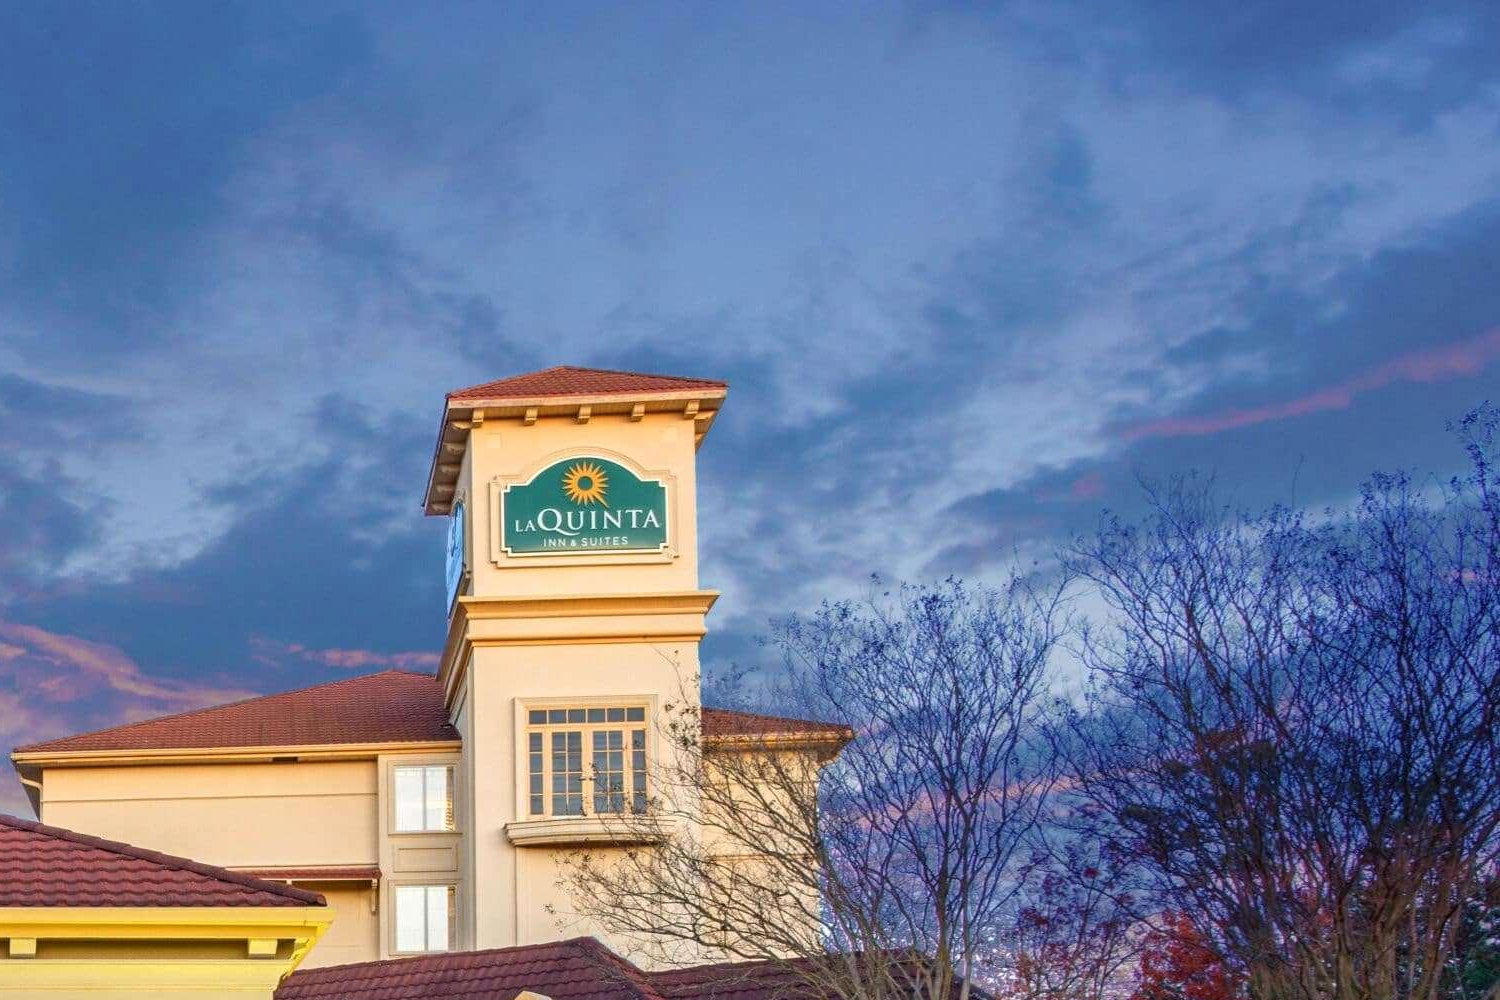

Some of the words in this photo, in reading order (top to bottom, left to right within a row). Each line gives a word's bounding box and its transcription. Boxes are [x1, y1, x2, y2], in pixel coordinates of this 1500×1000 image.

[537, 508, 660, 536] QUINTA
[543, 537, 566, 547] INN
[570, 538, 577, 547] &
[581, 536, 629, 547] SUITES
